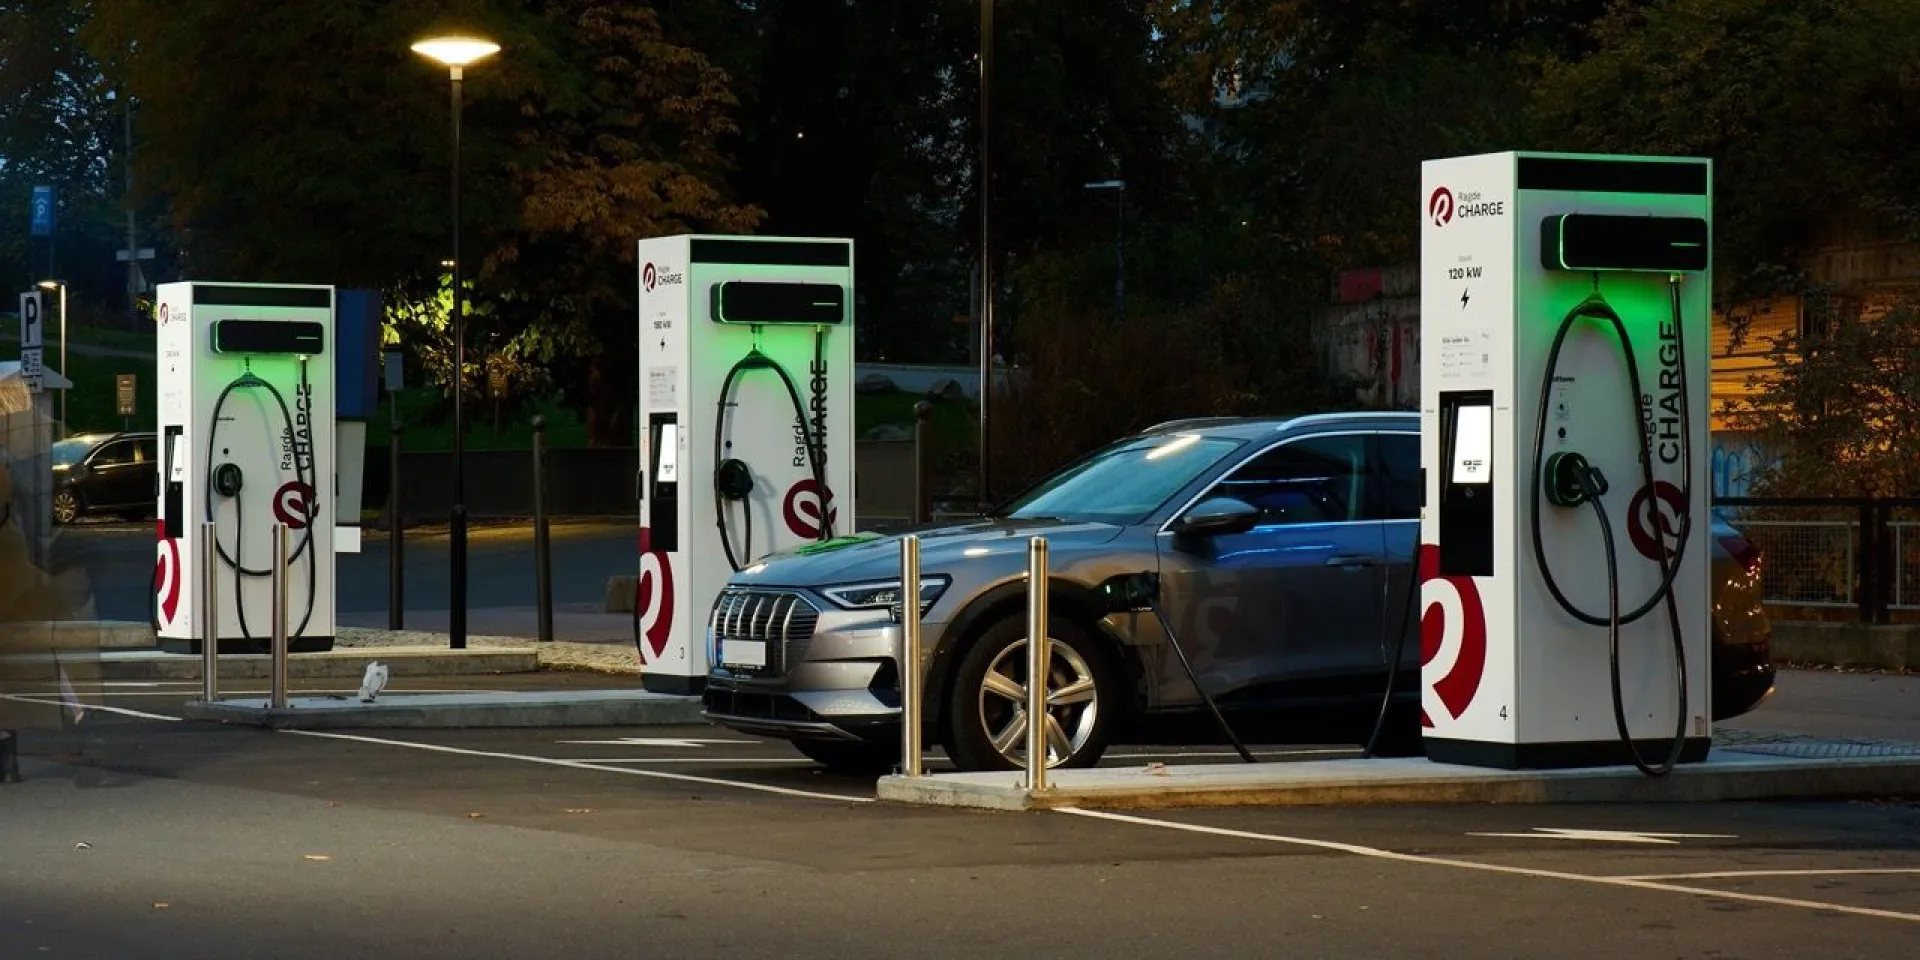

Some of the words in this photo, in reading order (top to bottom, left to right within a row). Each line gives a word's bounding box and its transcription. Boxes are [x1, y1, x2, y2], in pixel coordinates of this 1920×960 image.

[1458, 191, 1481, 203] Ragde
[1458, 201, 1504, 218] CHARGE
[1449, 267, 1464, 279] 120
[1466, 266, 1482, 278] kW
[25, 296, 38, 343] P
[1658, 320, 1680, 465] CHARGE
[1500, 704, 1509, 721] 4
